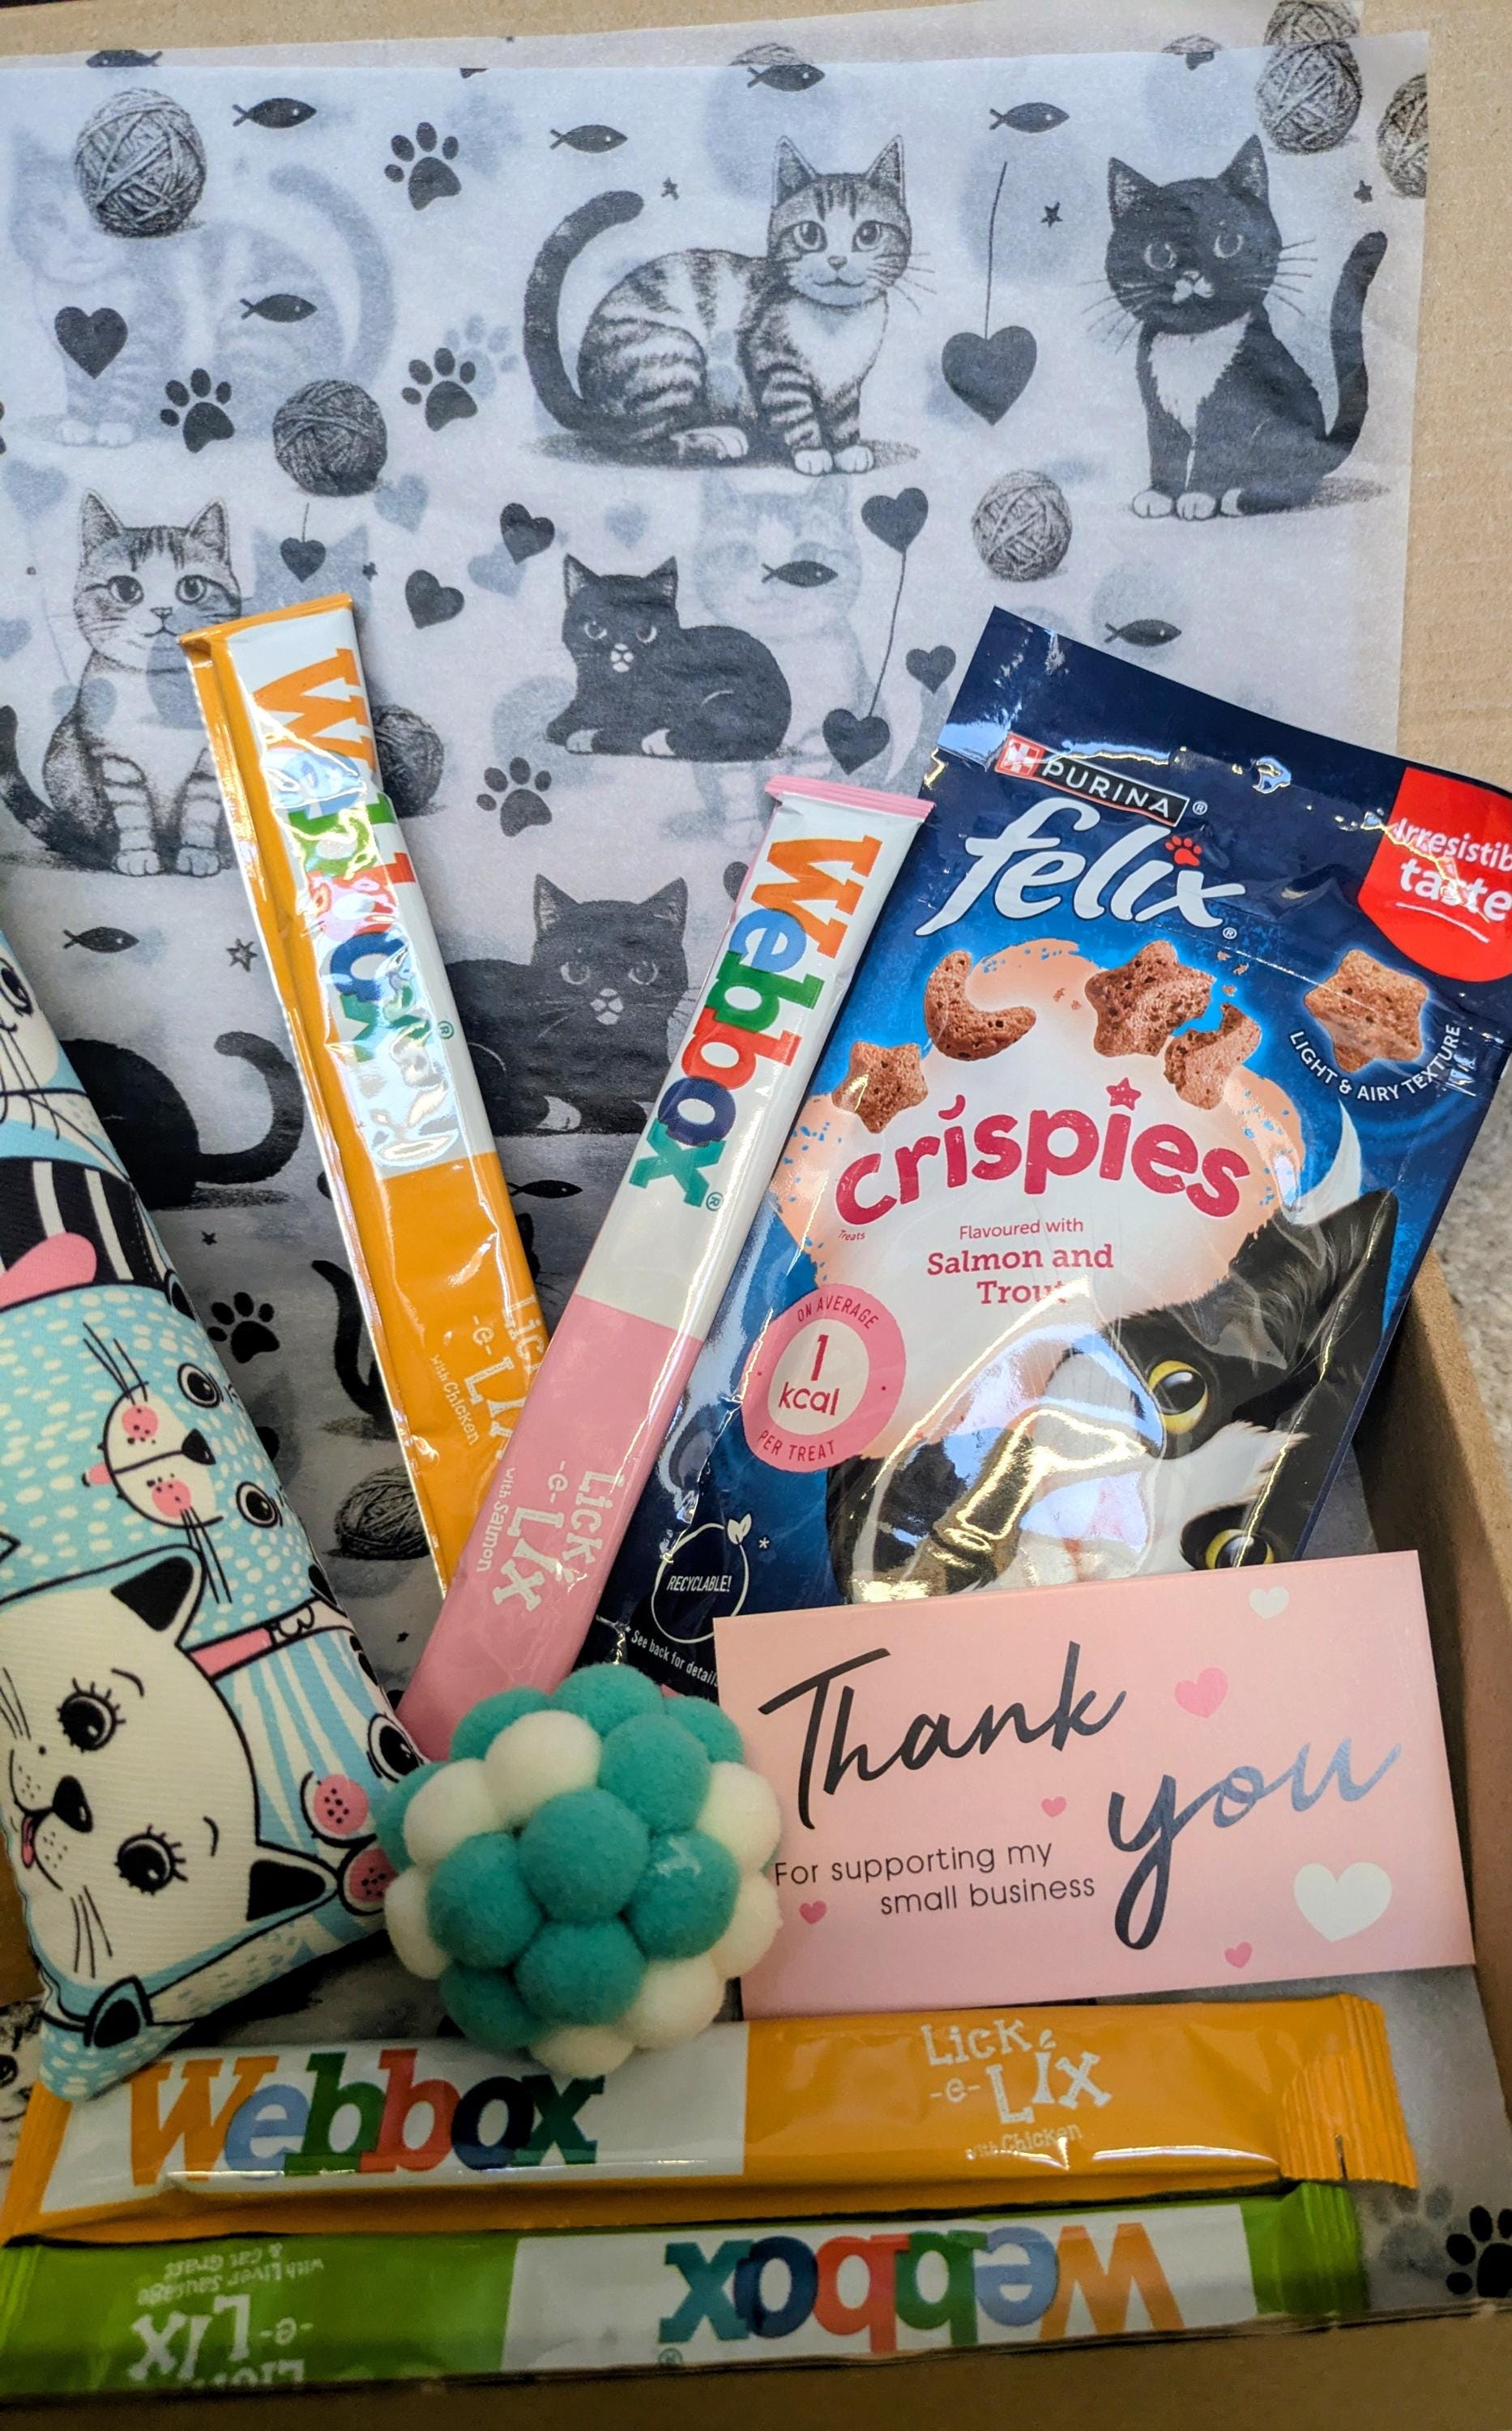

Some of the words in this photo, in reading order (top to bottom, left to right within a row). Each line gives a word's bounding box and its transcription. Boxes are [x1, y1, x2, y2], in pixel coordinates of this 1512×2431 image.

[1042, 762, 1170, 818] PURINA
[1400, 859, 1512, 921] taste
[629, 835, 882, 1207] Webbox
[1289, 1030, 1338, 1084] LIGHT
[1339, 1078, 1353, 1094] &
[1356, 1083, 1400, 1102] AIRY
[1402, 1023, 1461, 1100] TEXTURE
[835, 1077, 1250, 1225] crispies
[838, 1229, 865, 1241] Treats
[959, 1219, 1040, 1240] Flavoured
[1045, 1218, 1084, 1233] with
[927, 1250, 1044, 1275] Salmon
[1053, 1244, 1114, 1269] and
[797, 1304, 813, 1322] ON
[817, 1295, 878, 1329] AVERAGE
[810, 1335, 829, 1381] 1
[430, 1354, 448, 1381] with
[443, 1381, 480, 1446] Chicken
[778, 1382, 839, 1416] kcal
[758, 1429, 783, 1455] PER
[788, 1439, 835, 1461] TREAT
[499, 1468, 515, 1498] with
[476, 1500, 509, 1572] Salmon
[666, 1574, 732, 1592] RECYCLABLE!
[631, 1630, 648, 1648] See
[649, 1639, 670, 1661] back
[671, 1652, 685, 1669] for
[758, 1640, 1126, 1830] Thank
[775, 1861, 819, 1886] For
[831, 1844, 996, 1882] supporting
[1008, 1842, 1053, 1871] my
[1108, 1737, 1401, 1950] you
[879, 1886, 958, 1916] small
[971, 1873, 1096, 1908] business
[130, 2049, 605, 2186] Webbox
[657, 2222, 1185, 2353] Webbox
